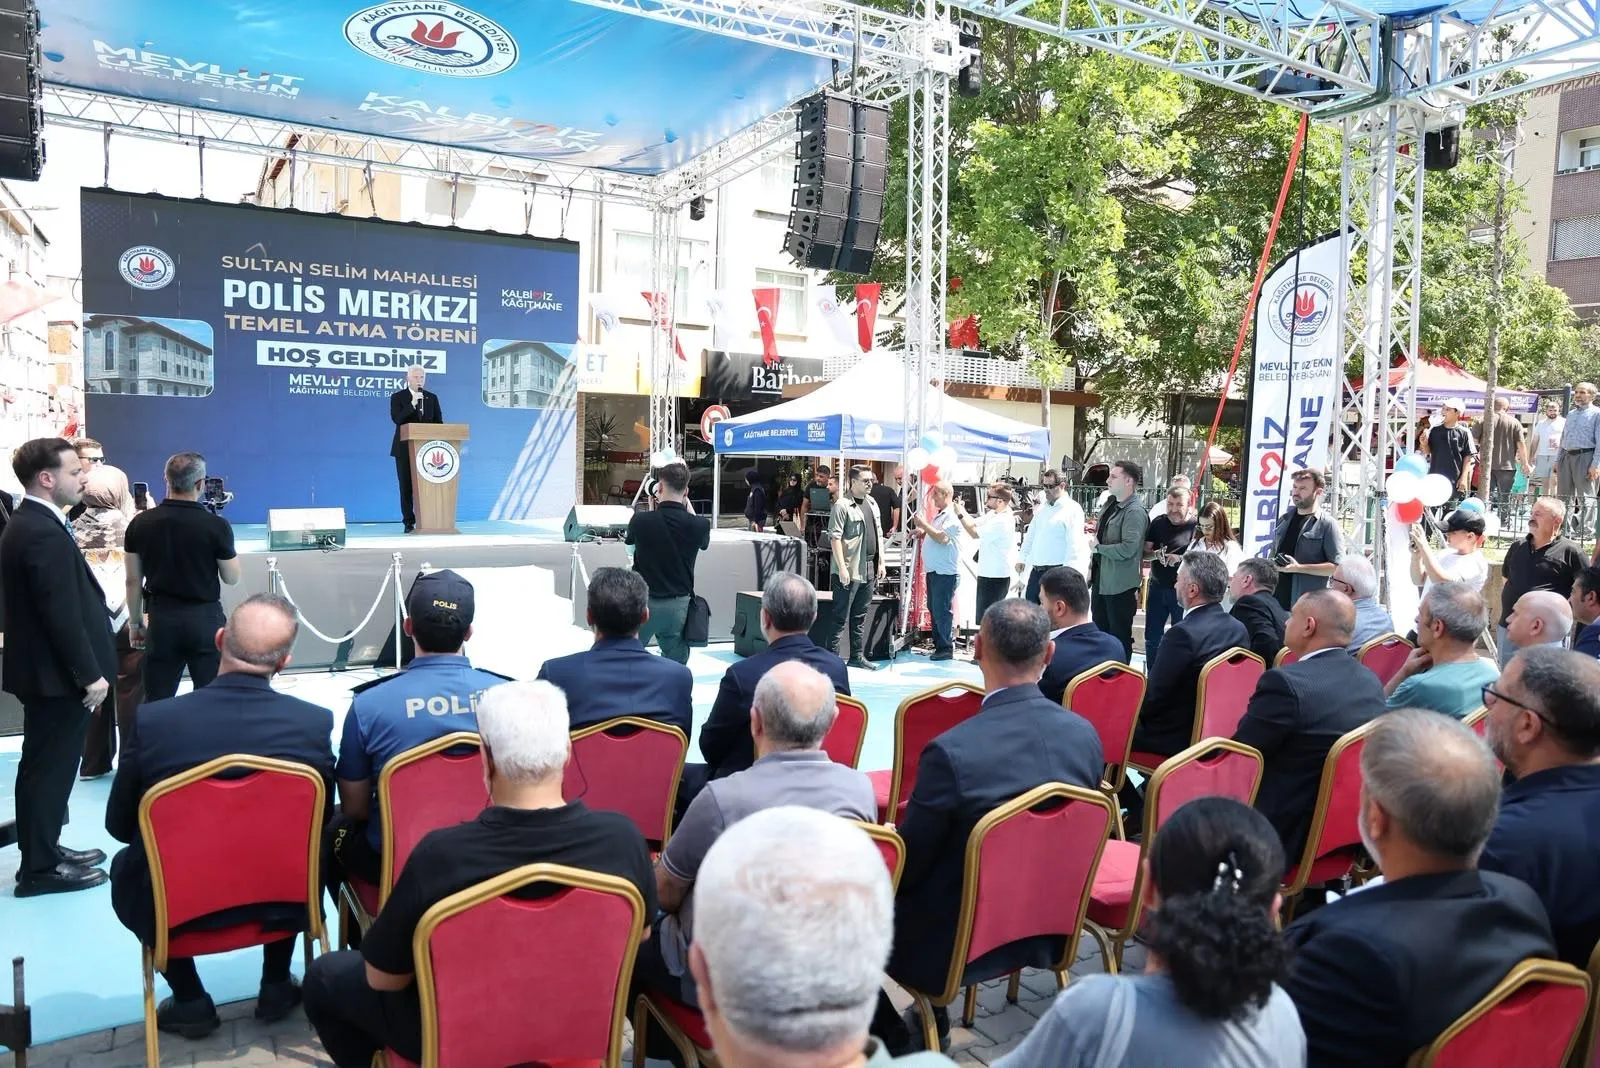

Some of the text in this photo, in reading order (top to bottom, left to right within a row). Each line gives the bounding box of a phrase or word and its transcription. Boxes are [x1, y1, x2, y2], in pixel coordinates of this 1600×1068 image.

[221, 255, 478, 290] SULTAN SELİM MAHALLESİ
[223, 277, 478, 324] POLİS MERKEZİ
[225, 314, 477, 345] TEMEL ATMA TÖRENİ
[267, 346, 438, 370] HOŞ GELDİNİZ
[405, 690, 483, 719] POLİ
